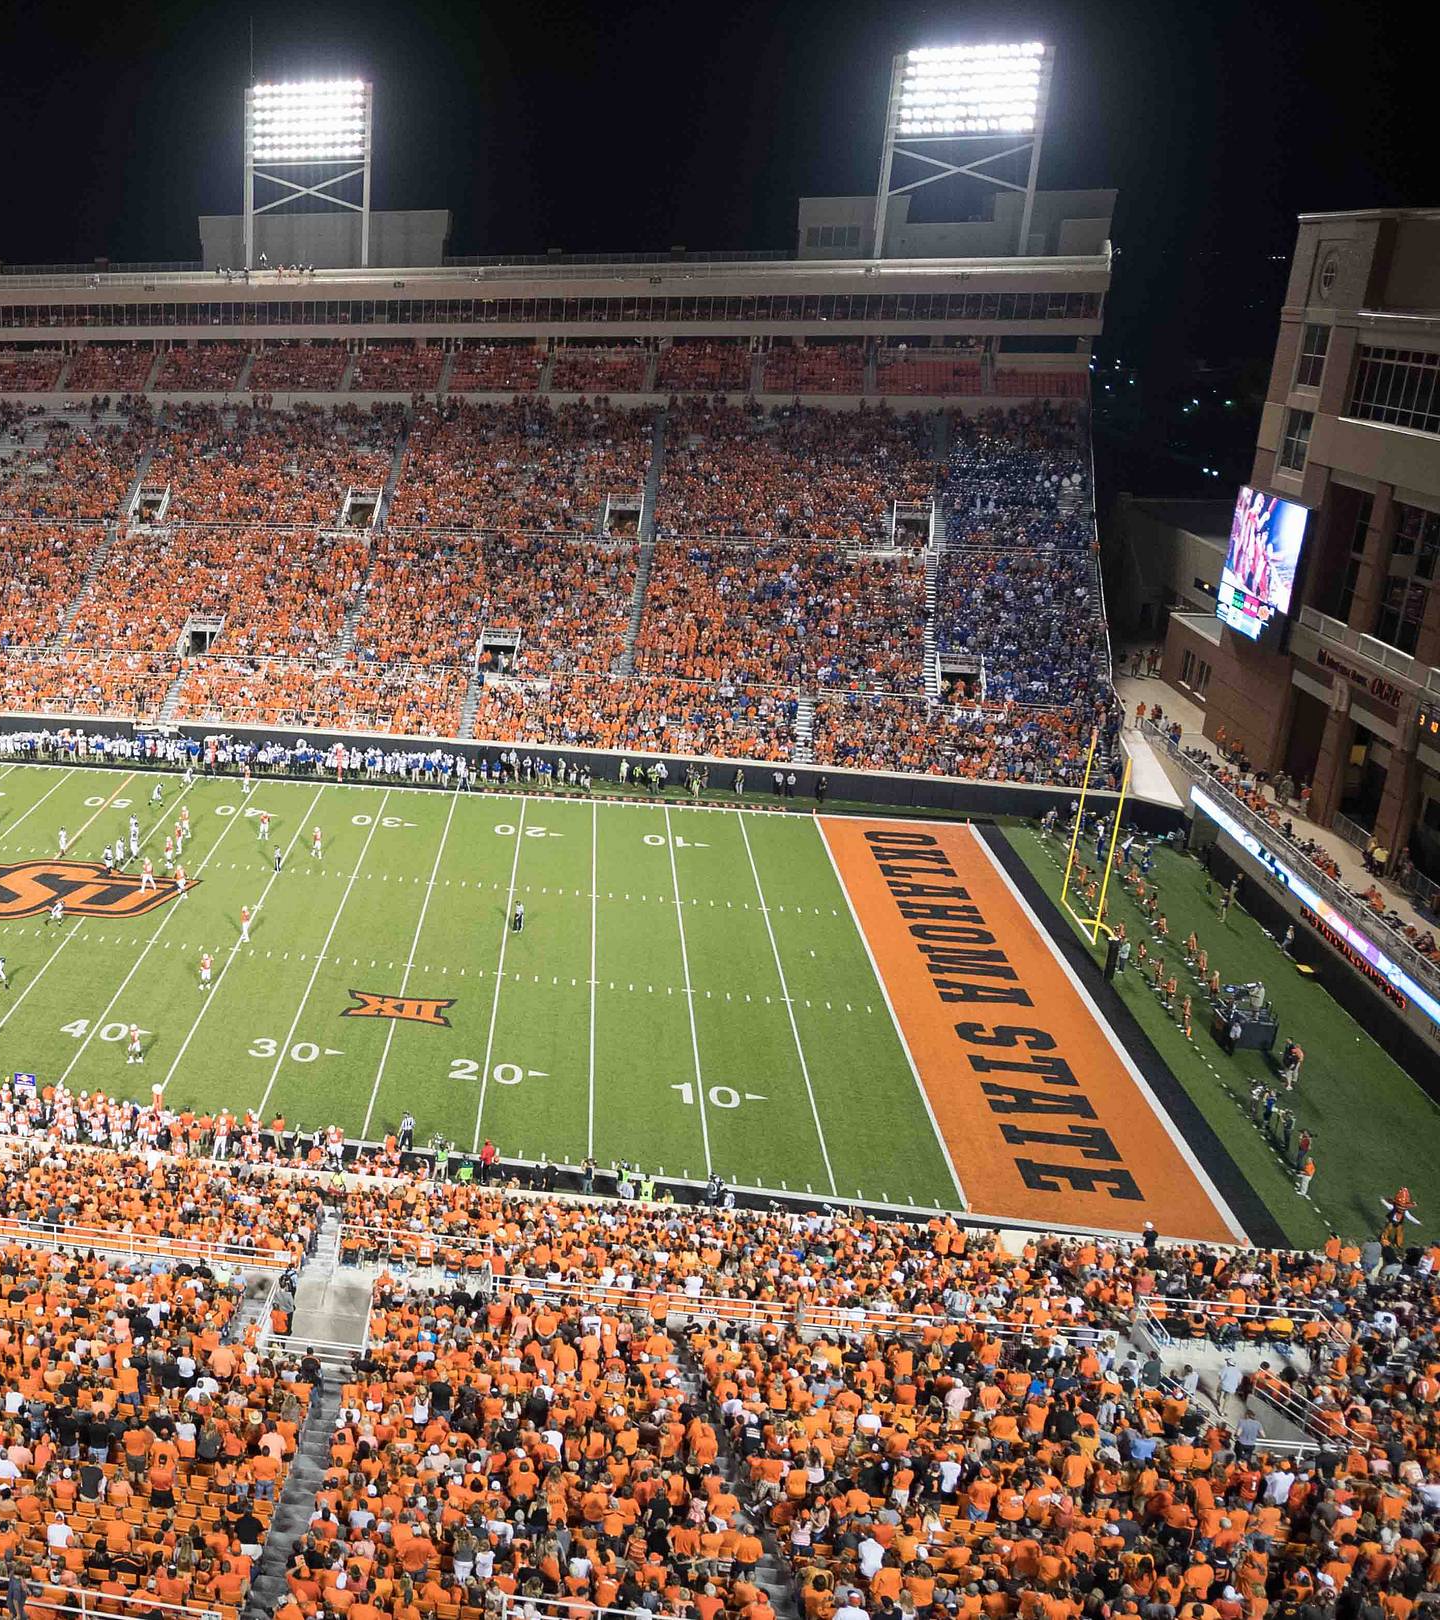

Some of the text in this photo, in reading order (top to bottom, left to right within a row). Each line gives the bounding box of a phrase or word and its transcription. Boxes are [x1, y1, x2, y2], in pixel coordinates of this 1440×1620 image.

[84, 796, 133, 808] 50
[351, 814, 402, 827] 30
[494, 824, 547, 838] 20
[643, 834, 692, 847] 10
[863, 830, 1146, 1201] OKLAHOMA STATE
[60, 1019, 129, 1042] 40
[247, 1038, 320, 1062] 30
[448, 1058, 523, 1084] 20
[670, 1082, 740, 1108] 10
